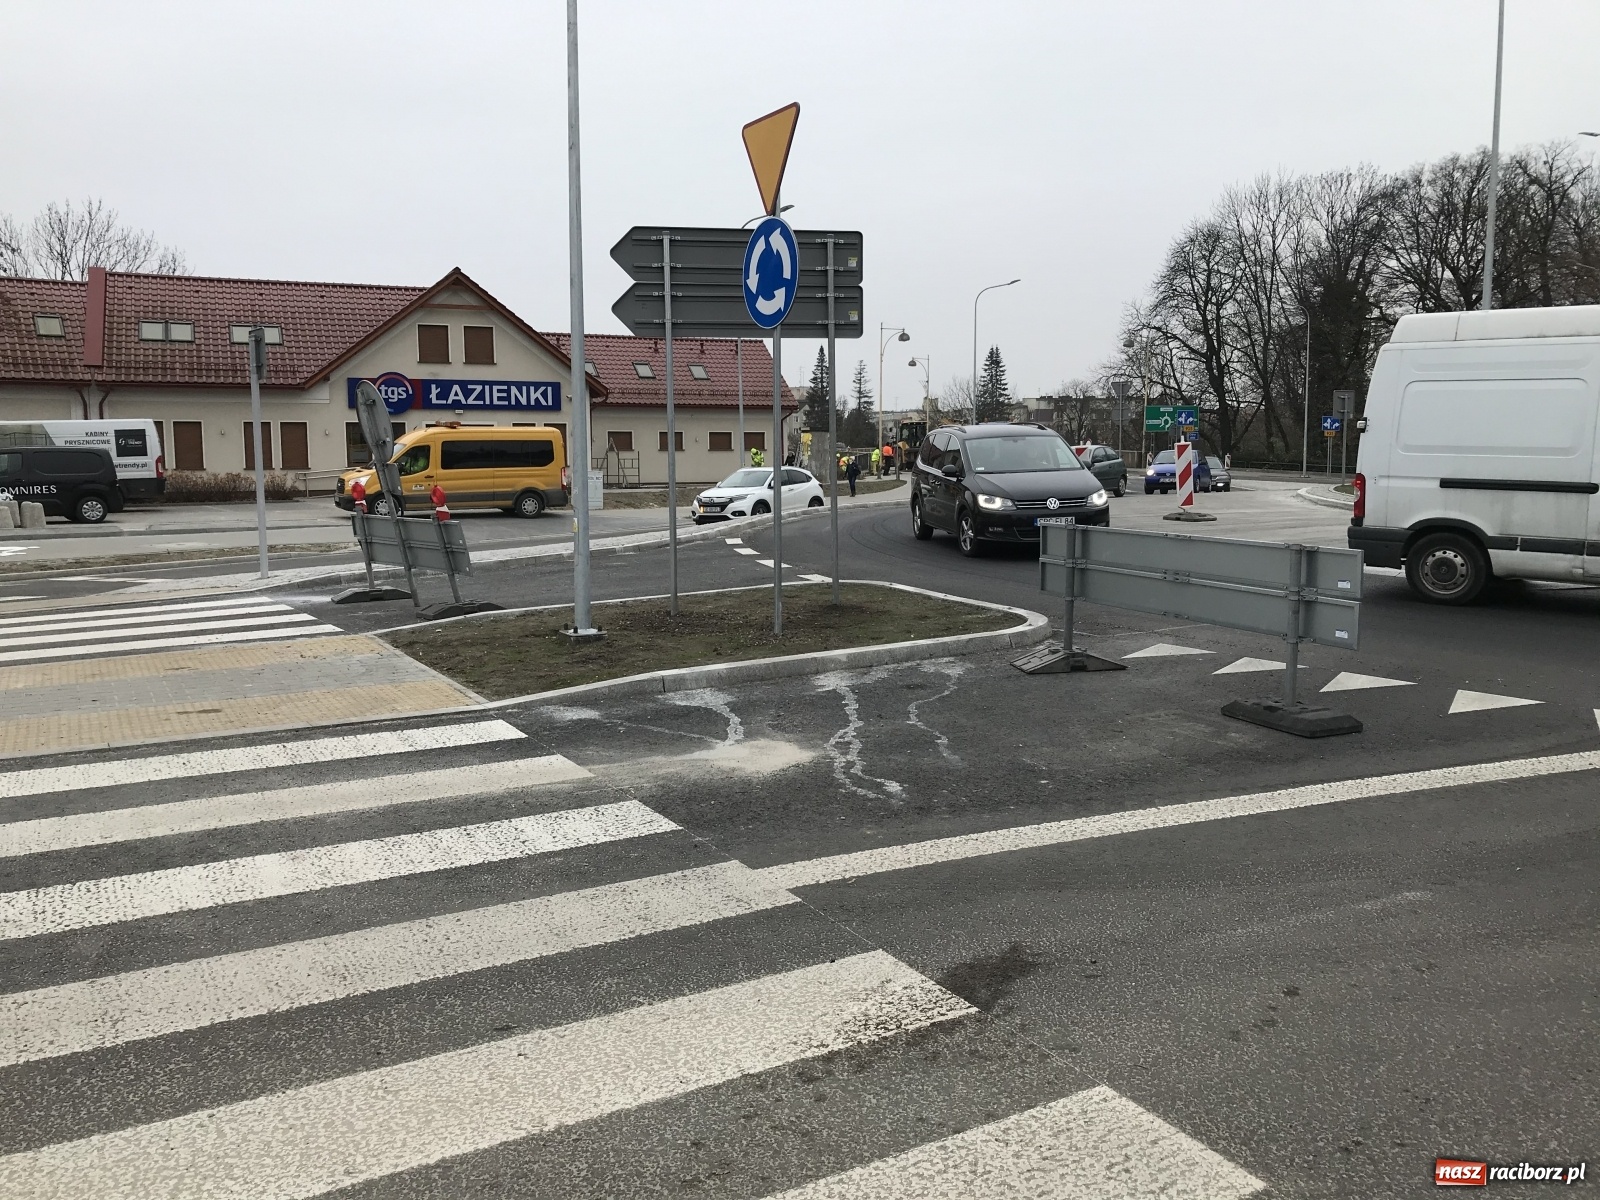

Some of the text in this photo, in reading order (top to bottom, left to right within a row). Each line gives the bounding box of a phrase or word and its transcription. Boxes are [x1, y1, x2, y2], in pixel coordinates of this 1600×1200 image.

[380, 384, 407, 402] tgs
[429, 383, 553, 406] ŁAZIENKI
[0, 484, 57, 495] OMNIRES
